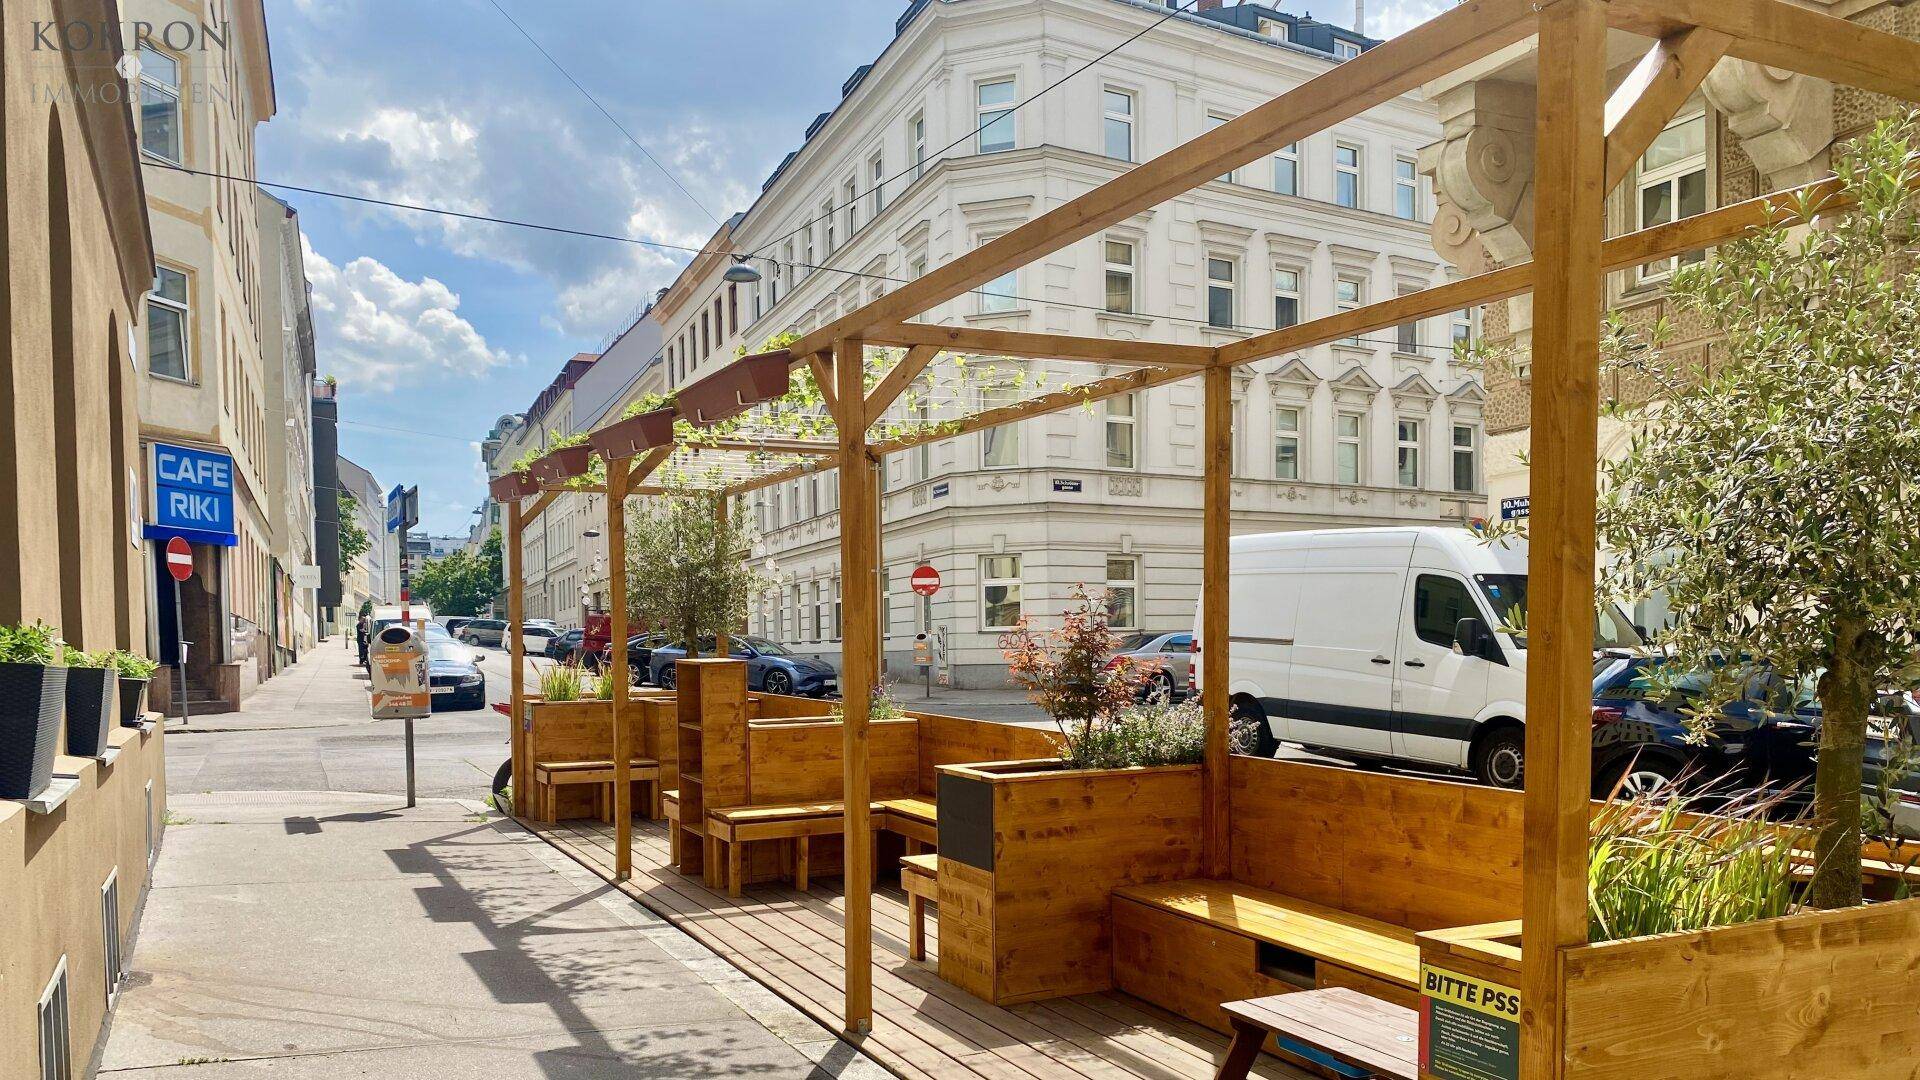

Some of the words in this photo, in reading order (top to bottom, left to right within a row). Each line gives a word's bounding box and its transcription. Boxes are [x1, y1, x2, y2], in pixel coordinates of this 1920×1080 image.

[159, 453, 229, 488] CAFE
[170, 492, 219, 522] RIKI
[1426, 972, 1478, 1003] BITTE
[1481, 988, 1519, 1015] PSS
